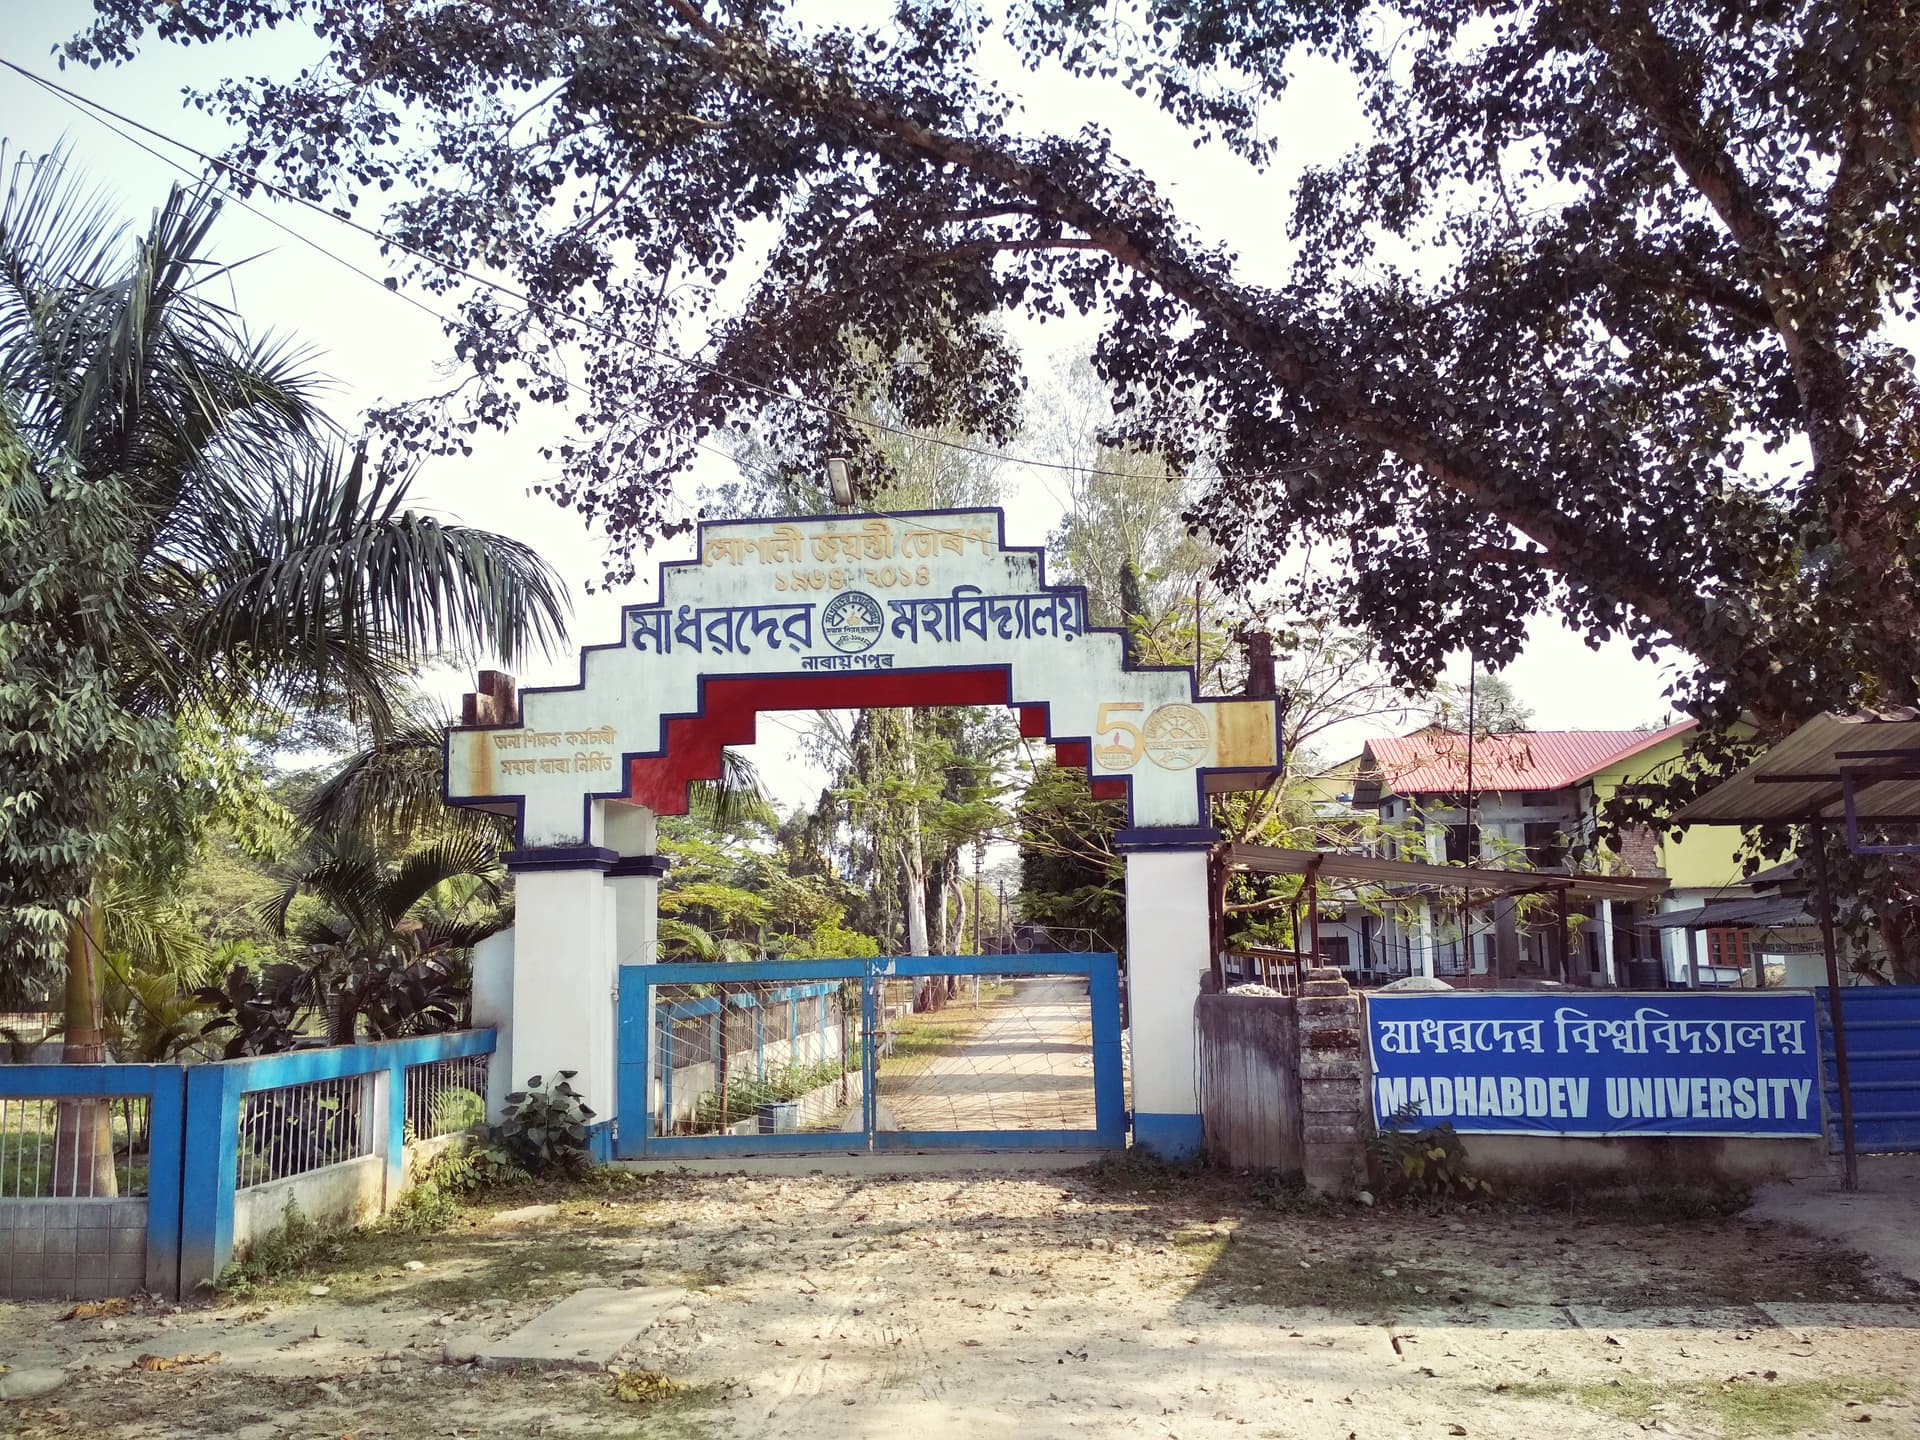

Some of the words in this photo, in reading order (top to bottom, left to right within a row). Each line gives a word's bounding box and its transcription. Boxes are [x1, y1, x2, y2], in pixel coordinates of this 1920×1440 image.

[629, 603, 816, 655] মাধৱদেৱ
[887, 584, 1082, 644] মহাবিদ্যালয়
[1378, 1019, 1544, 1053] মাধৱদেৱ
[1554, 1007, 1806, 1054] বিশ্ববিদ্যালয়
[1378, 1077, 1590, 1118] MADHABDEV
[1605, 1077, 1812, 1119] UNIVERSITY
